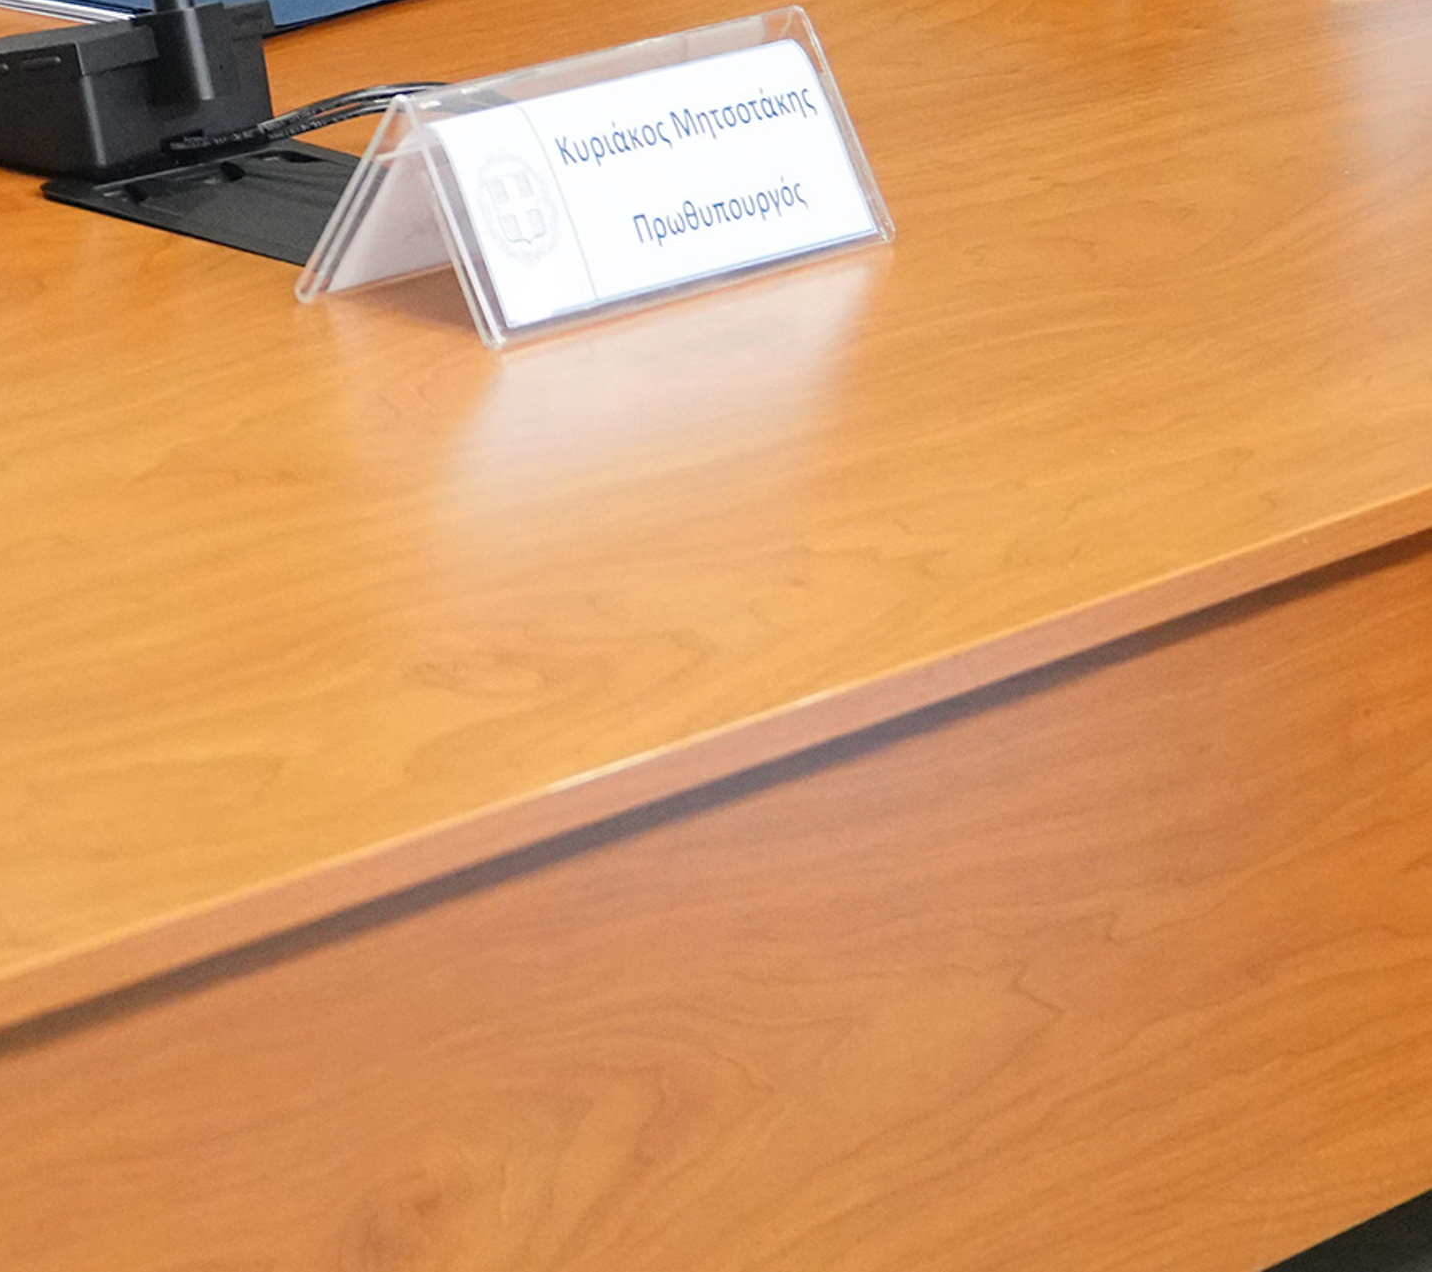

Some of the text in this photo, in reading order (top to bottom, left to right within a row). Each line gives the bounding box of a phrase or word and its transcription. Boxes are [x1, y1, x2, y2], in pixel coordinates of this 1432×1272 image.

[554, 88, 818, 167] Κυριάκος Μητσοτάκης
[633, 176, 809, 247] Πρωθυπουργός
